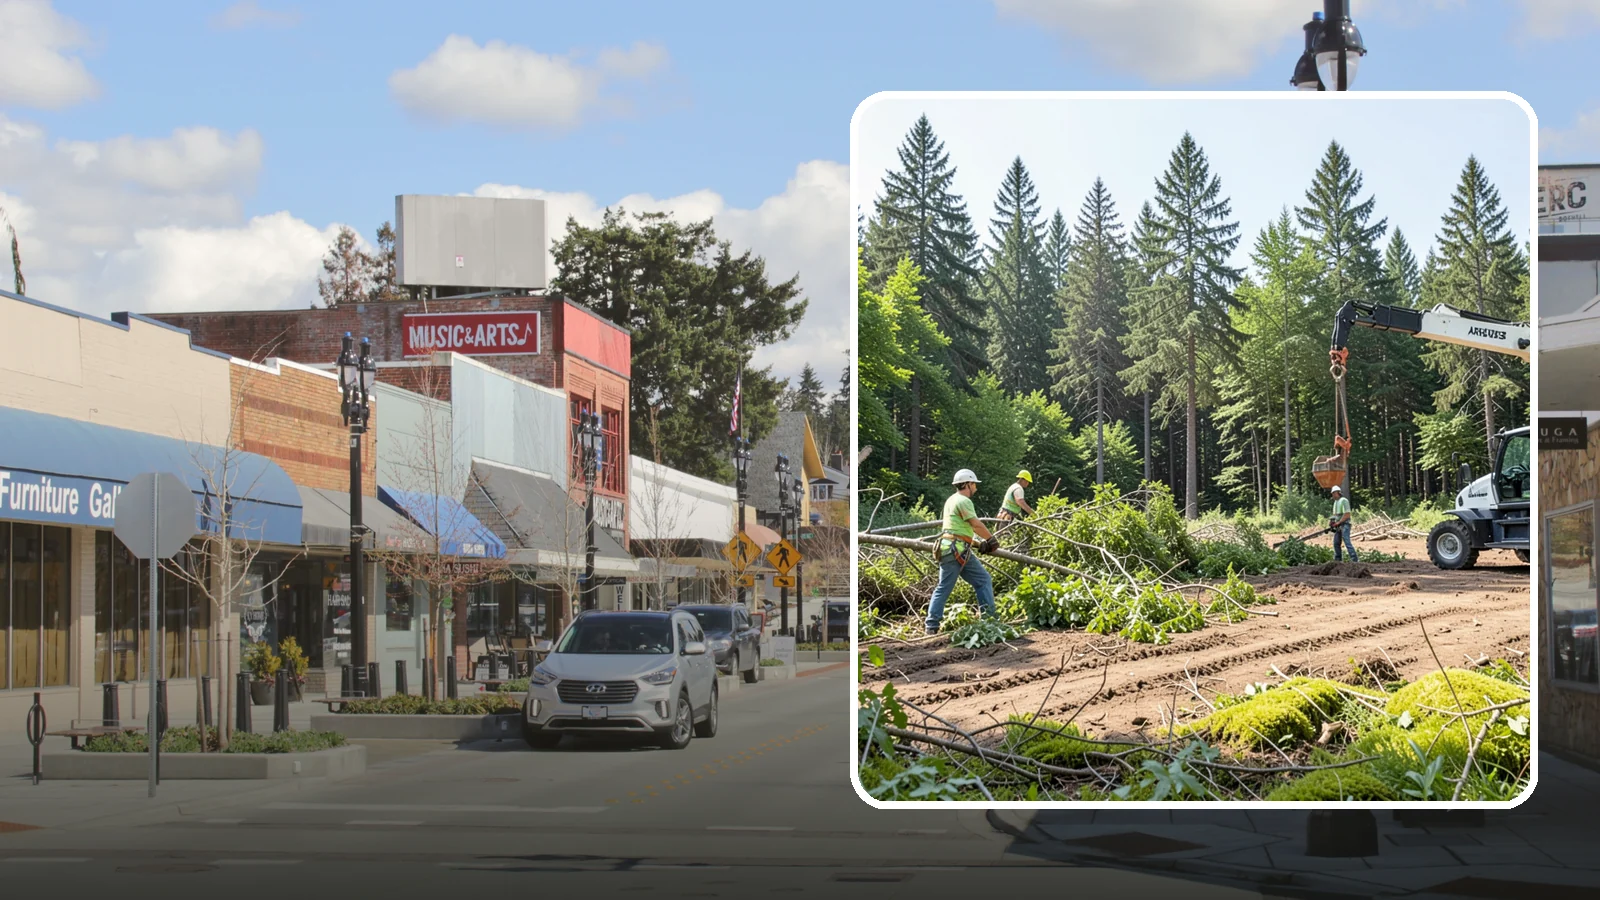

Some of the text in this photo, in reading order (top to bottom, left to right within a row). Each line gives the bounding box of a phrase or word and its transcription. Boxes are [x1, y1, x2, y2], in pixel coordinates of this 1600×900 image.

[0, 471, 122, 519] Furniture Gal
[453, 563, 479, 574] SUSHI
